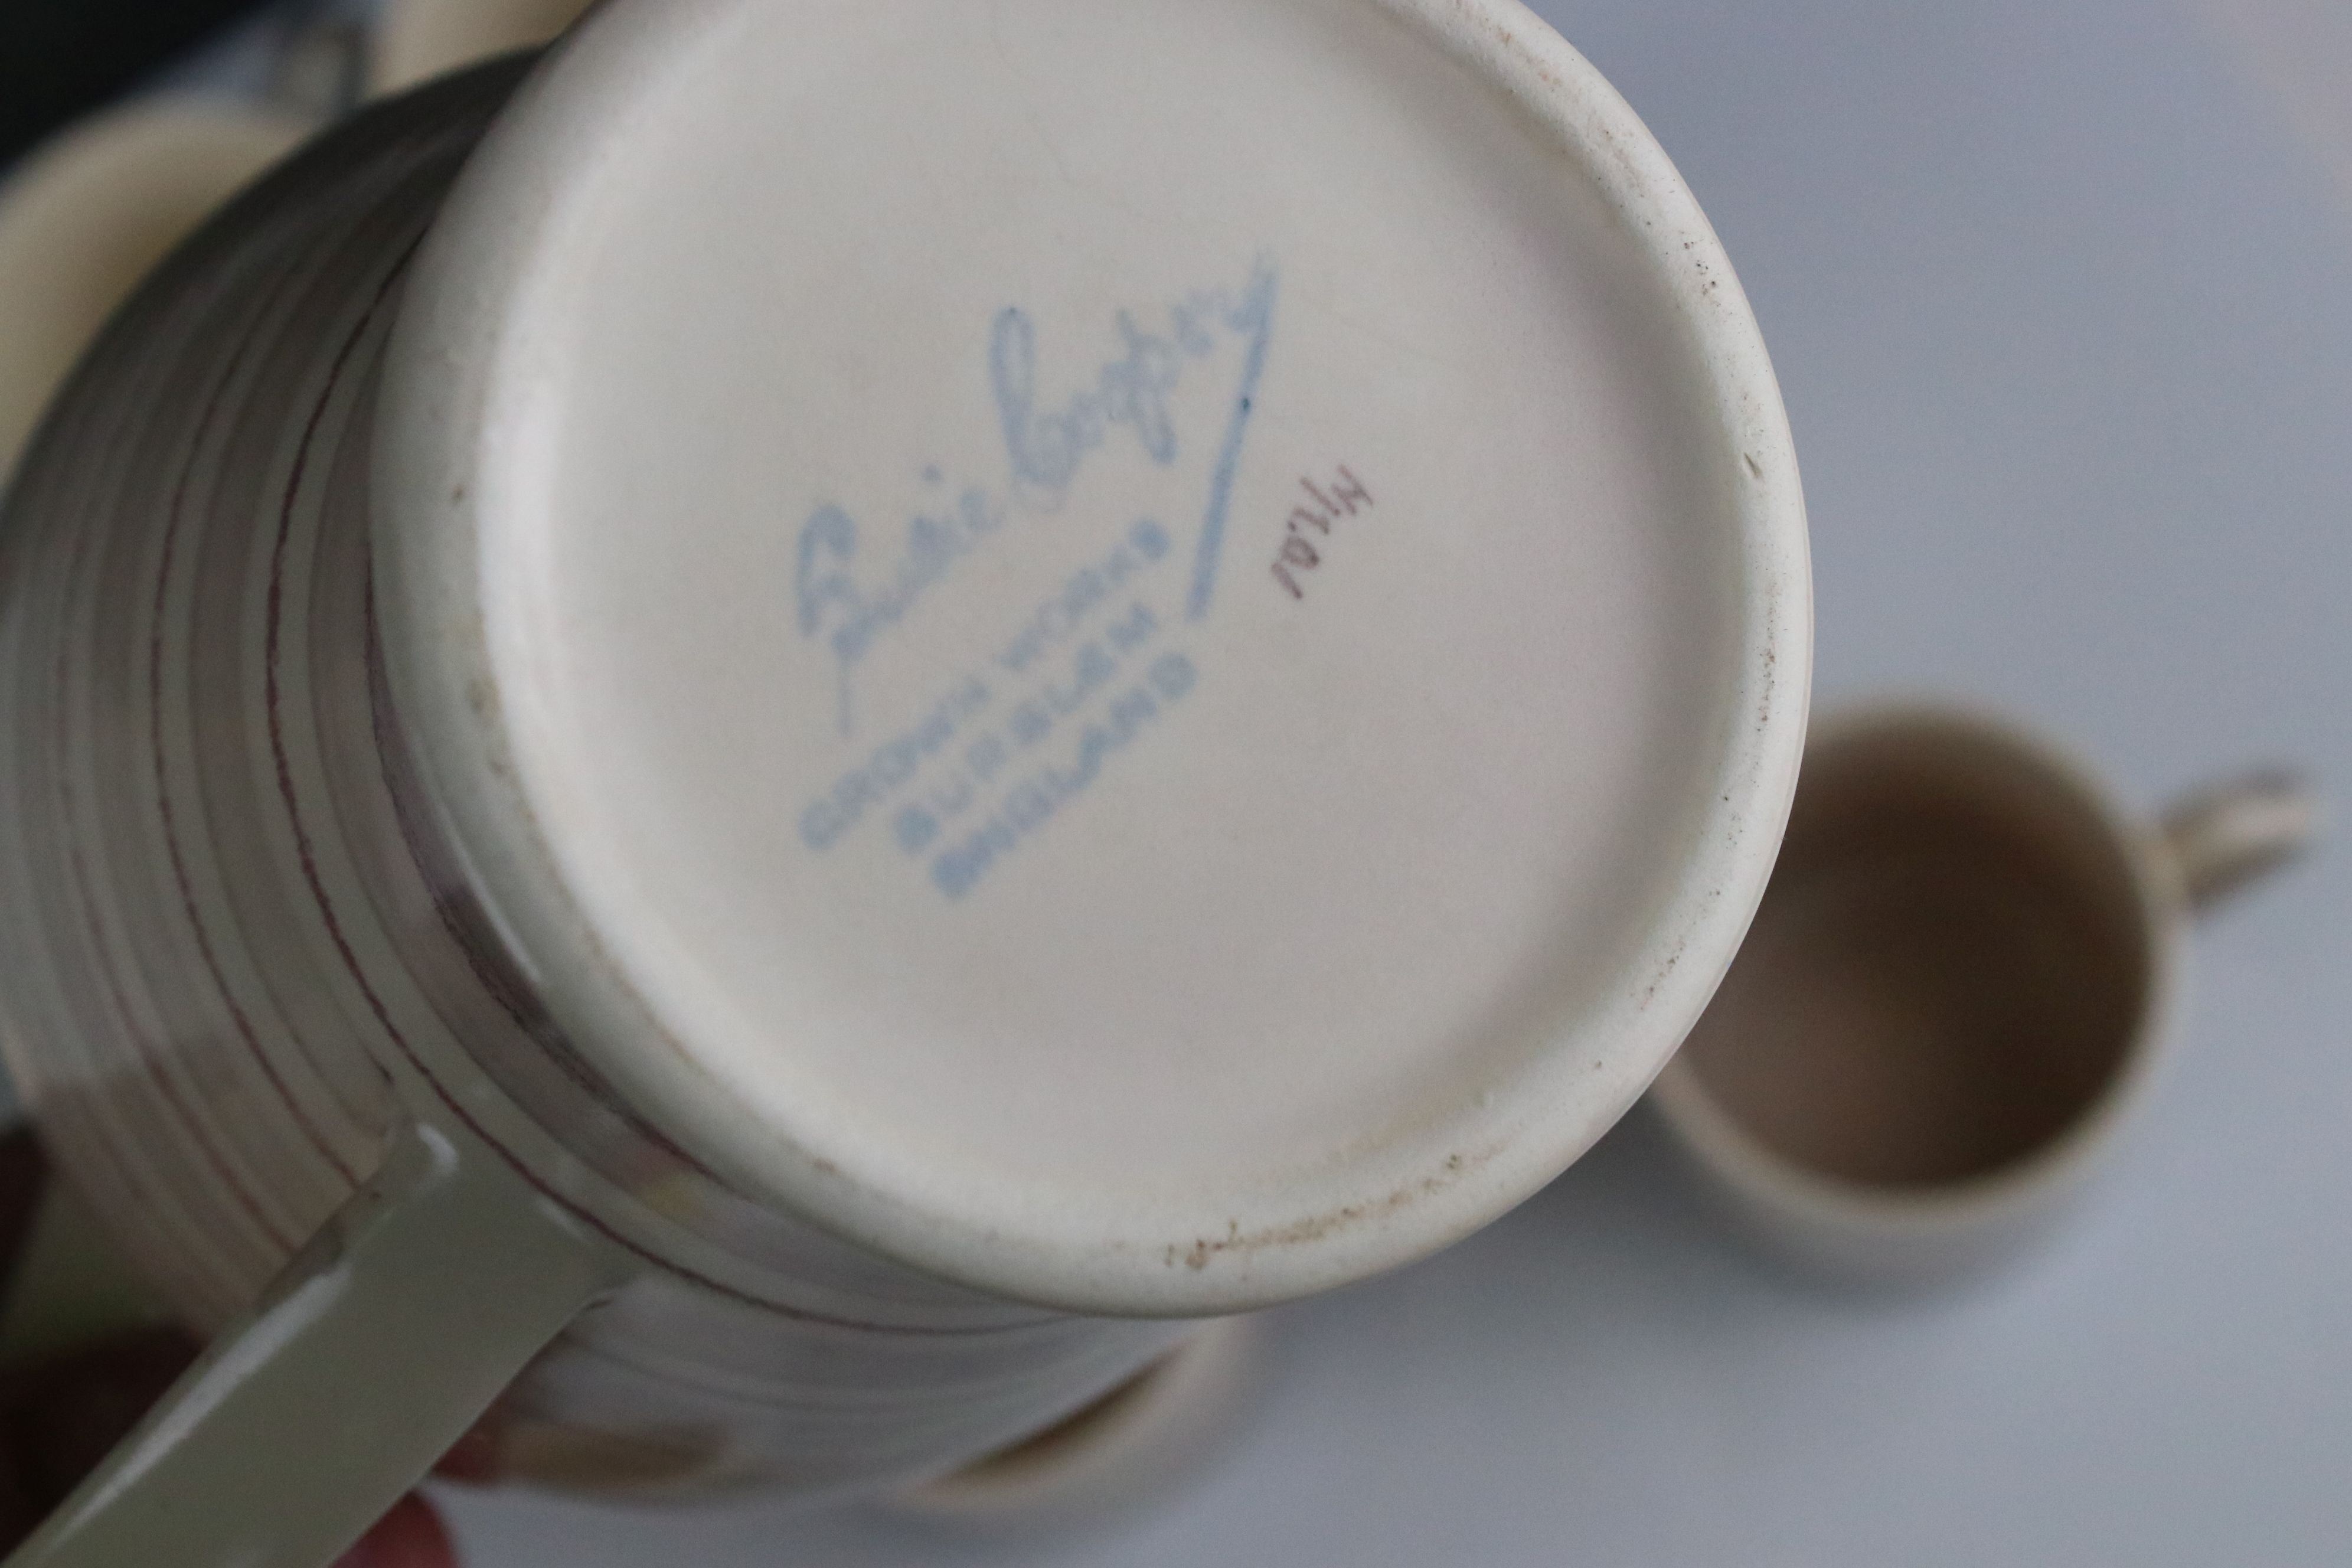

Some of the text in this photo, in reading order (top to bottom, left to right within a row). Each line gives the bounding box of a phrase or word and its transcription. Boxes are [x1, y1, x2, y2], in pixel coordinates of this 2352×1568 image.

[798, 518, 1171, 851] CROWN WORKS
[893, 601, 1156, 856] BURSLEM
[930, 652, 1200, 899] ENGLAND
